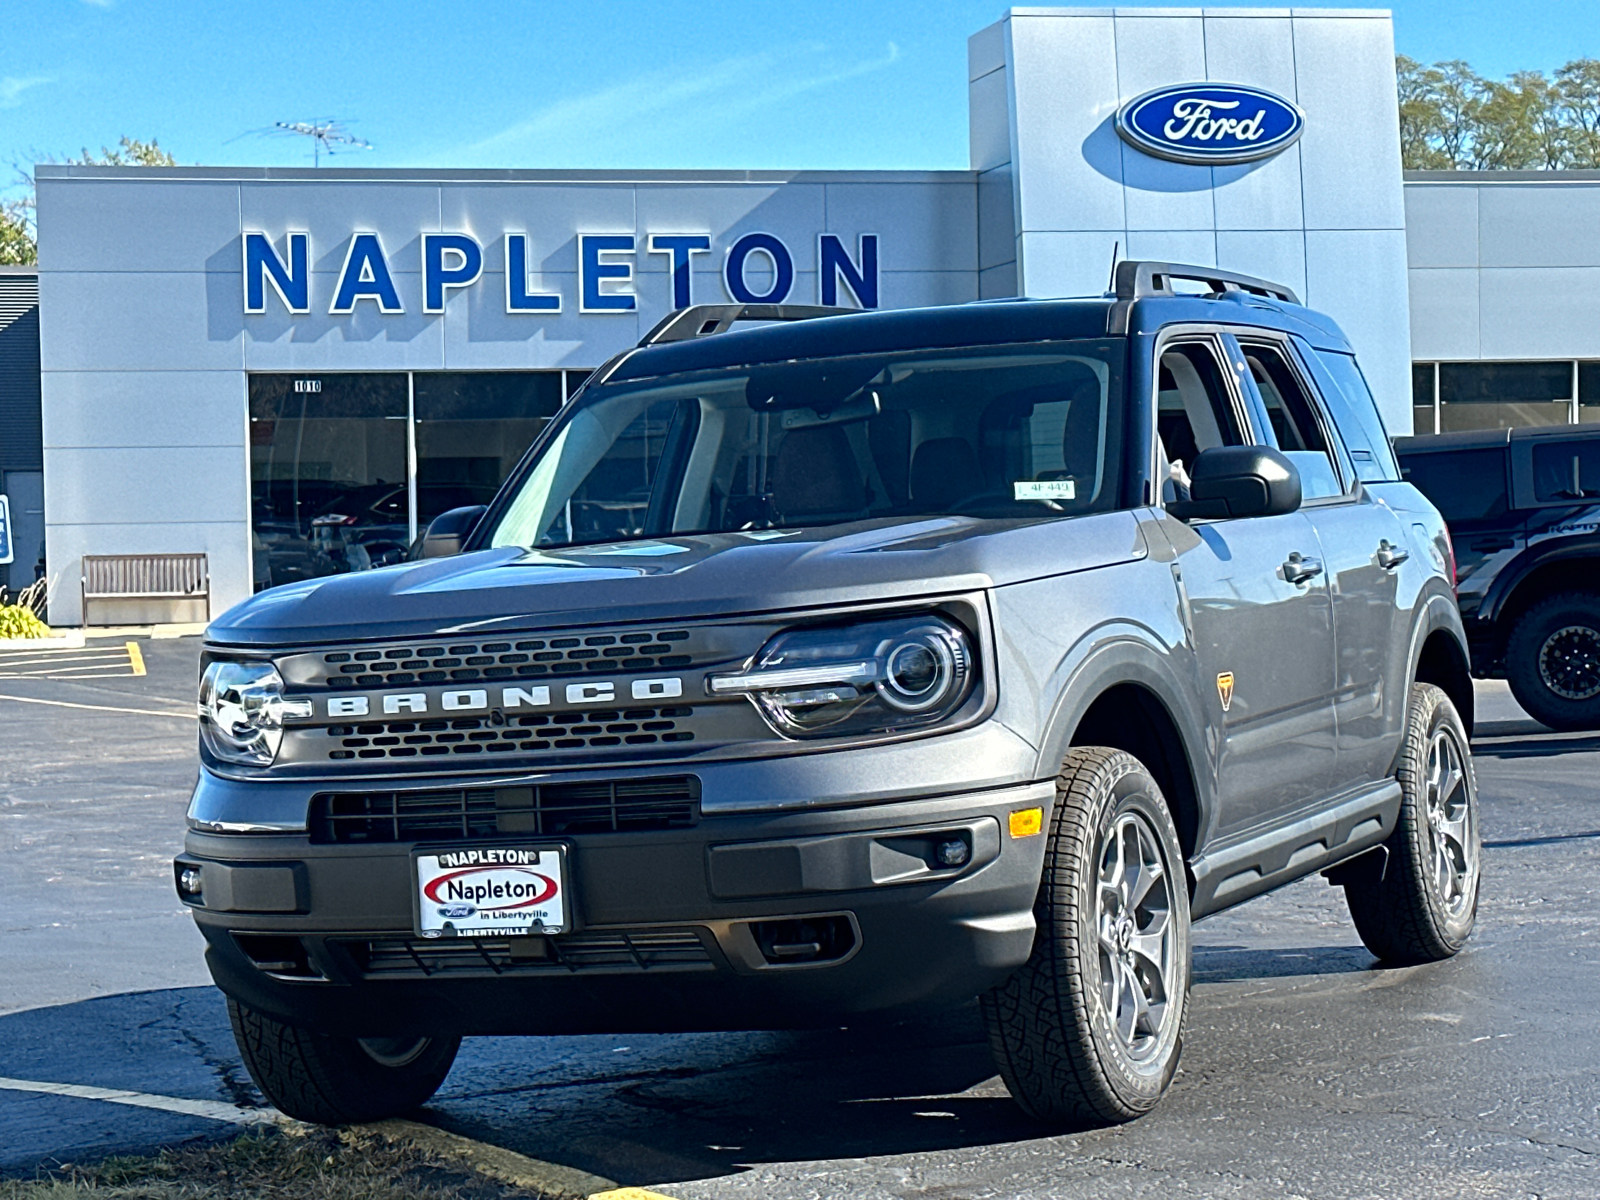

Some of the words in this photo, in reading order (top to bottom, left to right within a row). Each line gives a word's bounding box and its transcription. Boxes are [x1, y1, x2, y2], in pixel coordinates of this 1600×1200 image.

[1164, 98, 1266, 140] Ford
[241, 231, 880, 315] NAPLETON
[296, 381, 321, 391] 1010
[327, 678, 682, 717] BRONCO
[447, 850, 529, 867] NAPLETON
[447, 879, 537, 904] Napleton
[445, 907, 470, 917] Ford
[480, 911, 490, 919] in
[493, 910, 549, 920] Libertyville
[457, 928, 528, 937] LIBERTYVILLE
